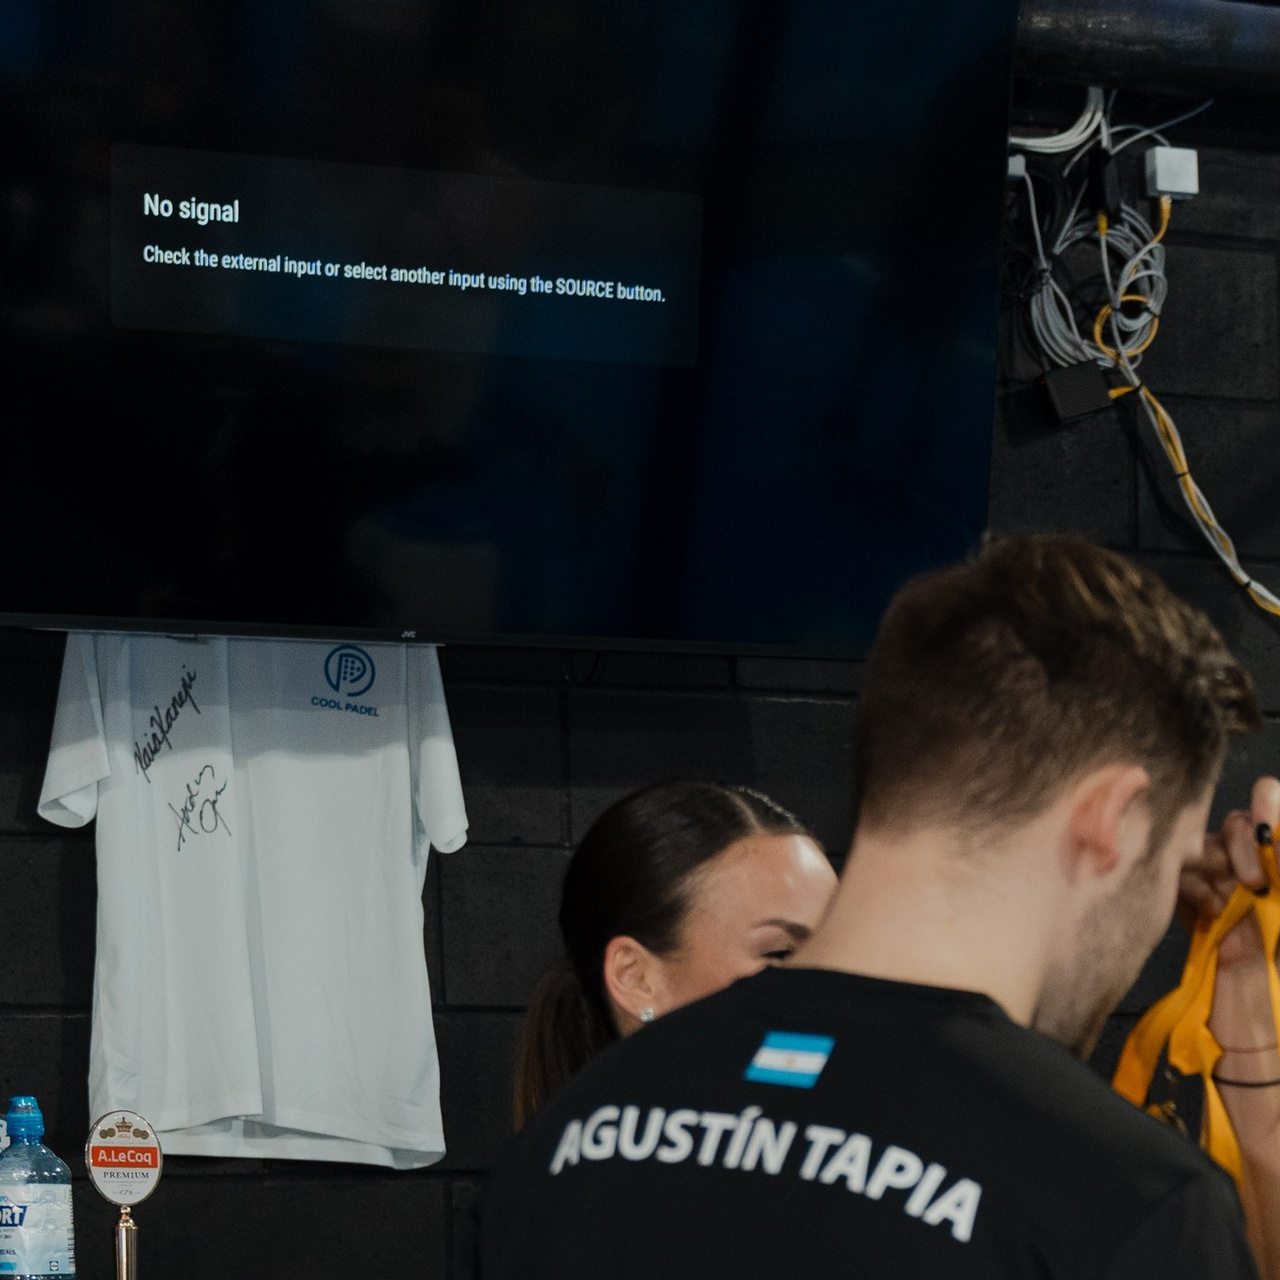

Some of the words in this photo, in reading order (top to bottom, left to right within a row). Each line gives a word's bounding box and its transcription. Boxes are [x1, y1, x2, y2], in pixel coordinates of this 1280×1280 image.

[144, 192, 173, 217] No
[179, 197, 240, 226] signal
[143, 245, 190, 266] Check
[194, 249, 219, 268] the
[221, 254, 281, 273] external
[284, 256, 322, 278] input
[324, 263, 341, 277] or
[344, 262, 388, 281] select
[390, 267, 446, 286] another
[449, 269, 486, 291] input
[488, 274, 527, 296] using
[530, 276, 553, 294] the
[556, 278, 614, 299] SOURCE
[616, 282, 666, 303] button.
[401, 630, 416, 639] JVC
[311, 696, 343, 711] COOL
[345, 702, 380, 717] PADEL
[103, 1171, 150, 1179] PREMIUM
[550, 1105, 797, 1175] AGUSTÍN
[801, 1124, 983, 1243] TAPIA
